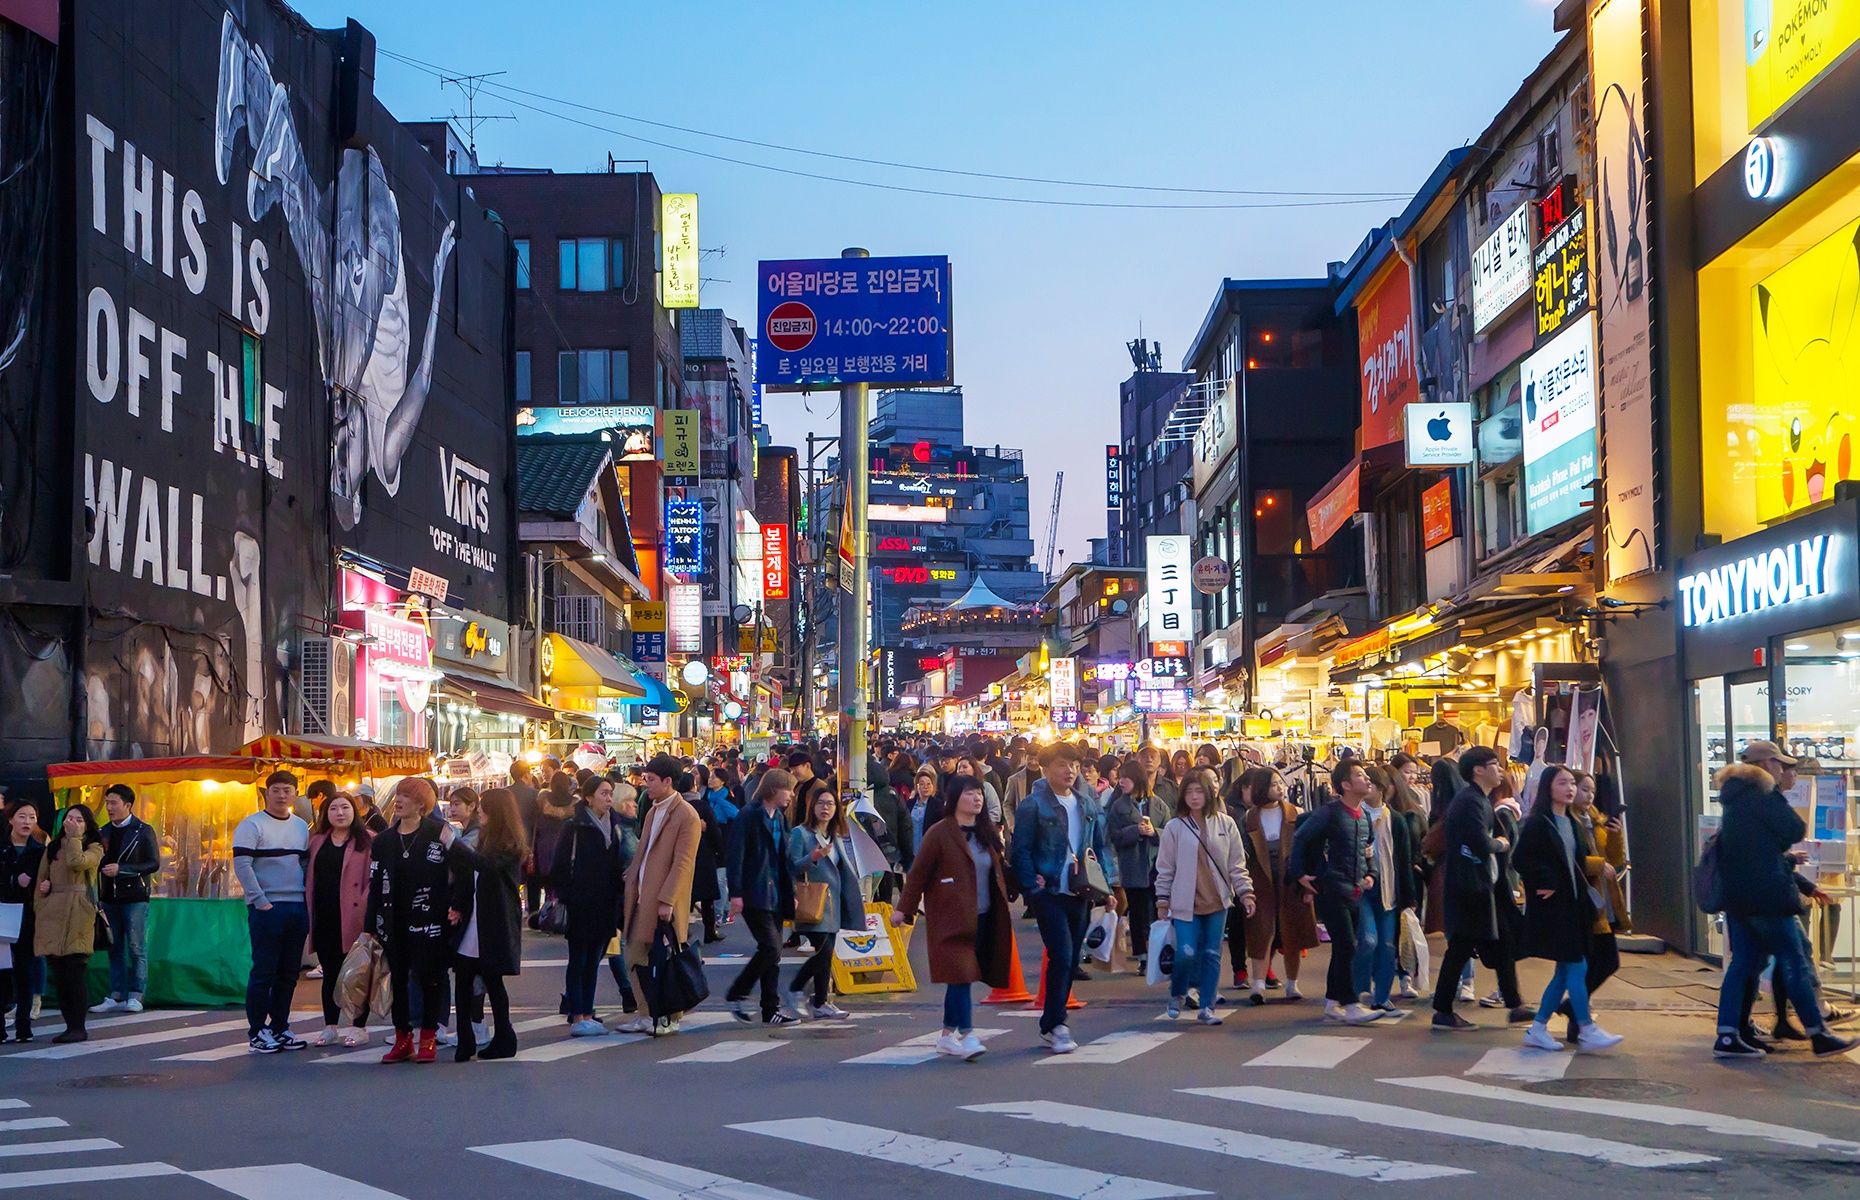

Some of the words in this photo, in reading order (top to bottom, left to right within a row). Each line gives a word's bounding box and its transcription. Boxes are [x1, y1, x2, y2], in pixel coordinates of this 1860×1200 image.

[1785, 39, 1823, 83] TONYMOLY
[85, 113, 208, 295] THIS
[230, 221, 270, 335] IS
[1507, 203, 1529, 259] 반지
[768, 271, 859, 297] 어울마당로
[867, 267, 940, 294] 진입금지
[1534, 247, 1569, 311] 헤나
[1571, 271, 1584, 295] 3F
[772, 320, 811, 334] 진입금지
[824, 316, 939, 337] 14:00~22:00
[1537, 298, 1566, 336] henna
[843, 354, 897, 374] 보행전용
[902, 353, 928, 373] 거리
[85, 285, 188, 433] OFF
[206, 350, 287, 480] THE
[558, 407, 614, 417] LEEJOOHEE
[615, 406, 652, 416] HENNA
[666, 461, 697, 471] 프렌즈
[675, 477, 688, 485] B1
[1618, 484, 1643, 504] TONYMOLY
[671, 506, 698, 516] ヘンナ
[84, 452, 227, 601] WALL.
[670, 526, 699, 534] TATTOO
[674, 535, 692, 545] 文身
[877, 537, 911, 551] ASSA
[765, 527, 782, 588] 보드게임
[893, 566, 929, 584] DVD
[1678, 534, 1836, 628] TONYMOLY
[765, 588, 784, 596] Cafe
[1161, 564, 1180, 630] 三丁目
[633, 609, 663, 620] 부동산
[1136, 689, 1189, 710] 타로
